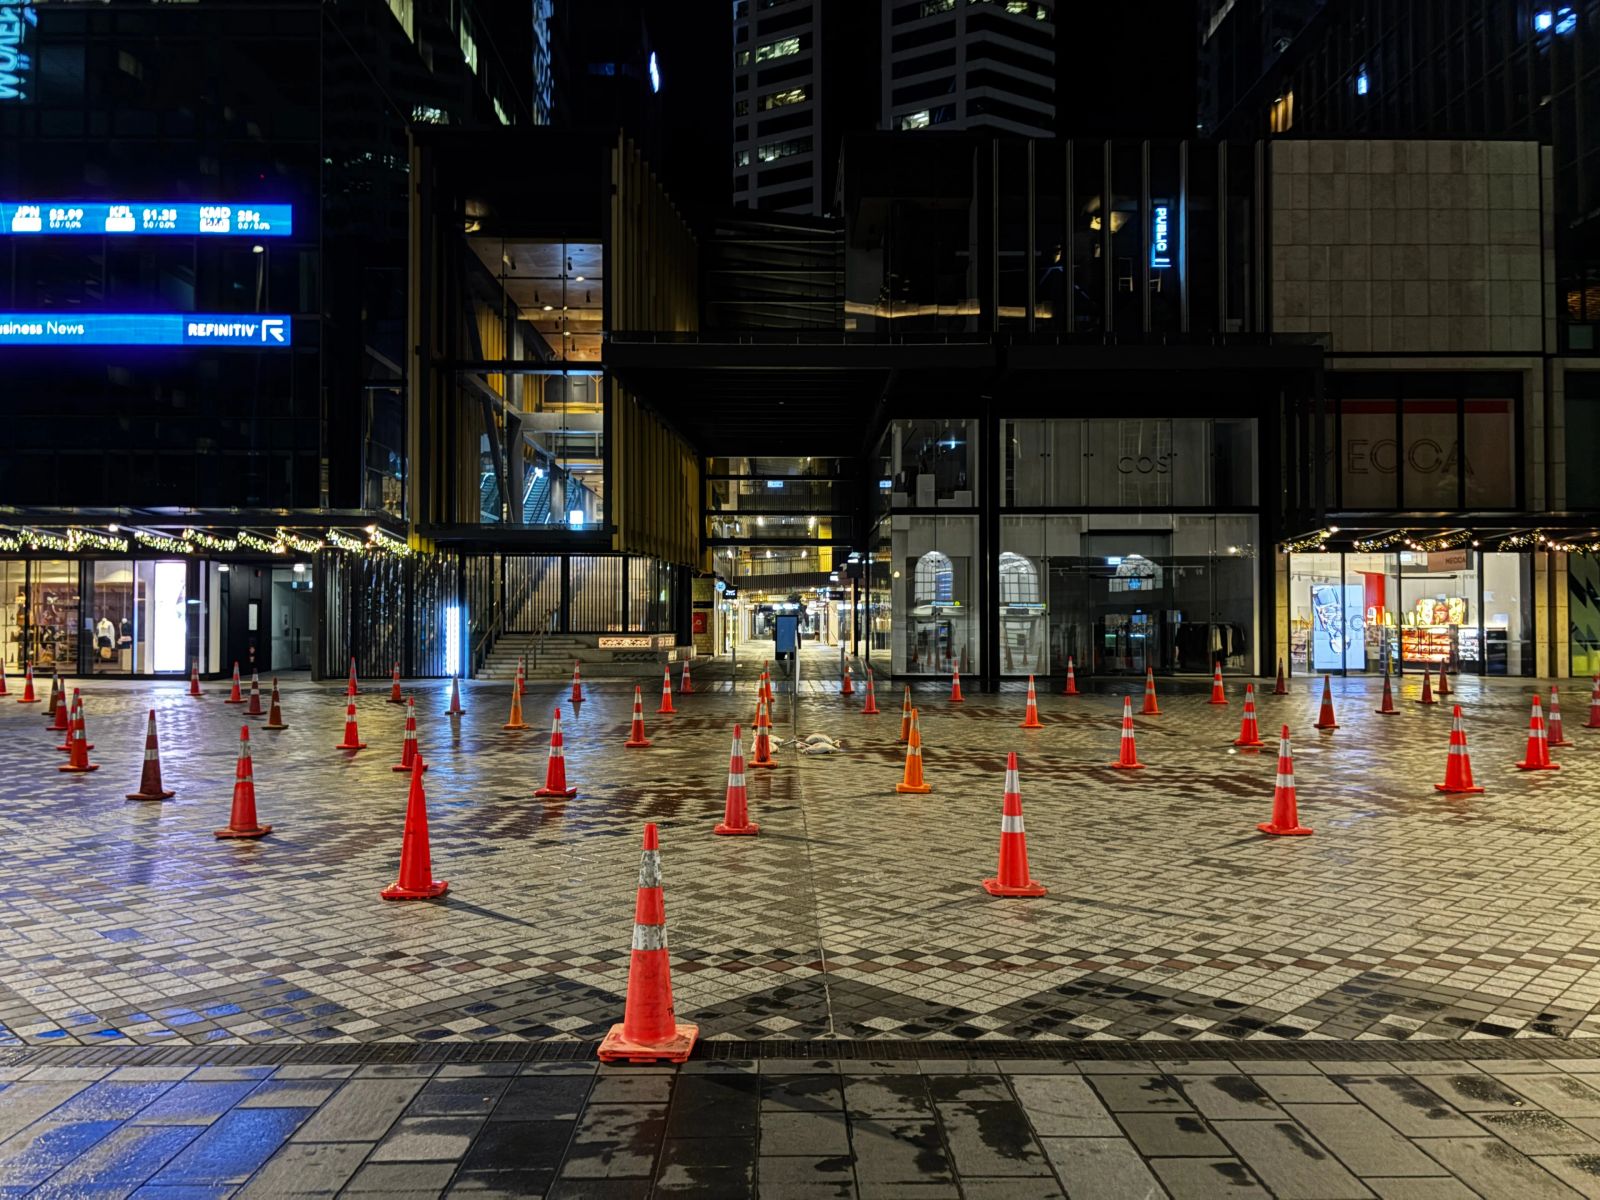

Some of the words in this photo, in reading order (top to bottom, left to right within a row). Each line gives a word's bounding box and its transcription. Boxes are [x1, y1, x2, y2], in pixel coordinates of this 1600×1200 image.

[0, 321, 43, 335] siness
[47, 321, 84, 335] News
[188, 323, 255, 337] REFINITIV
[1117, 455, 1173, 474] COS
[1347, 438, 1475, 475] ECCA
